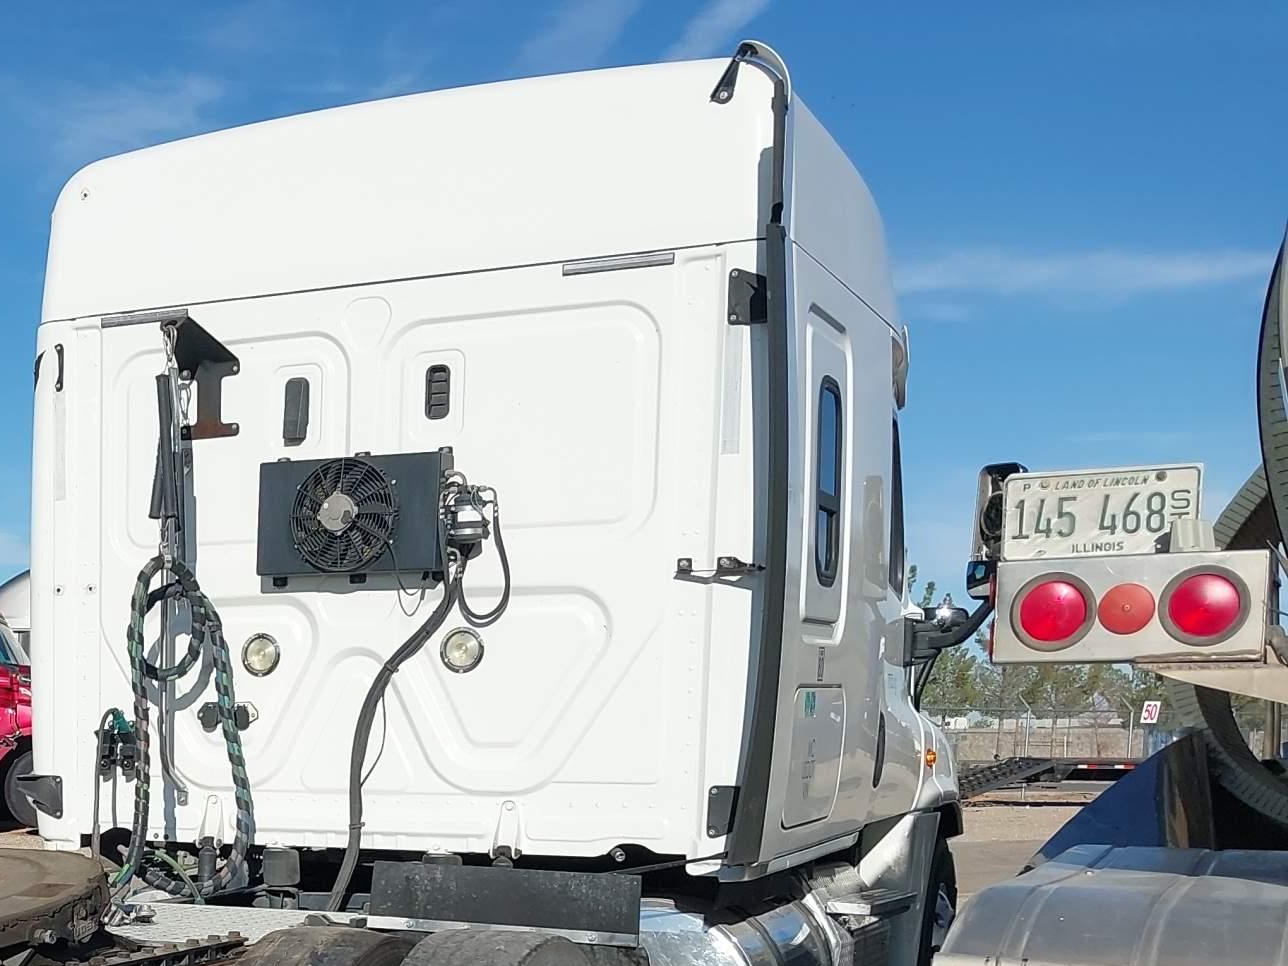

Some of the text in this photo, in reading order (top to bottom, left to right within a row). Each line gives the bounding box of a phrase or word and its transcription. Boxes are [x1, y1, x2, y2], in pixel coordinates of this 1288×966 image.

[1054, 474, 1150, 491] LAND OF LINCOLN
[1011, 491, 1166, 540] 145 468
[1071, 541, 1124, 554] ILLINOIS
[1143, 704, 1157, 720] 50
